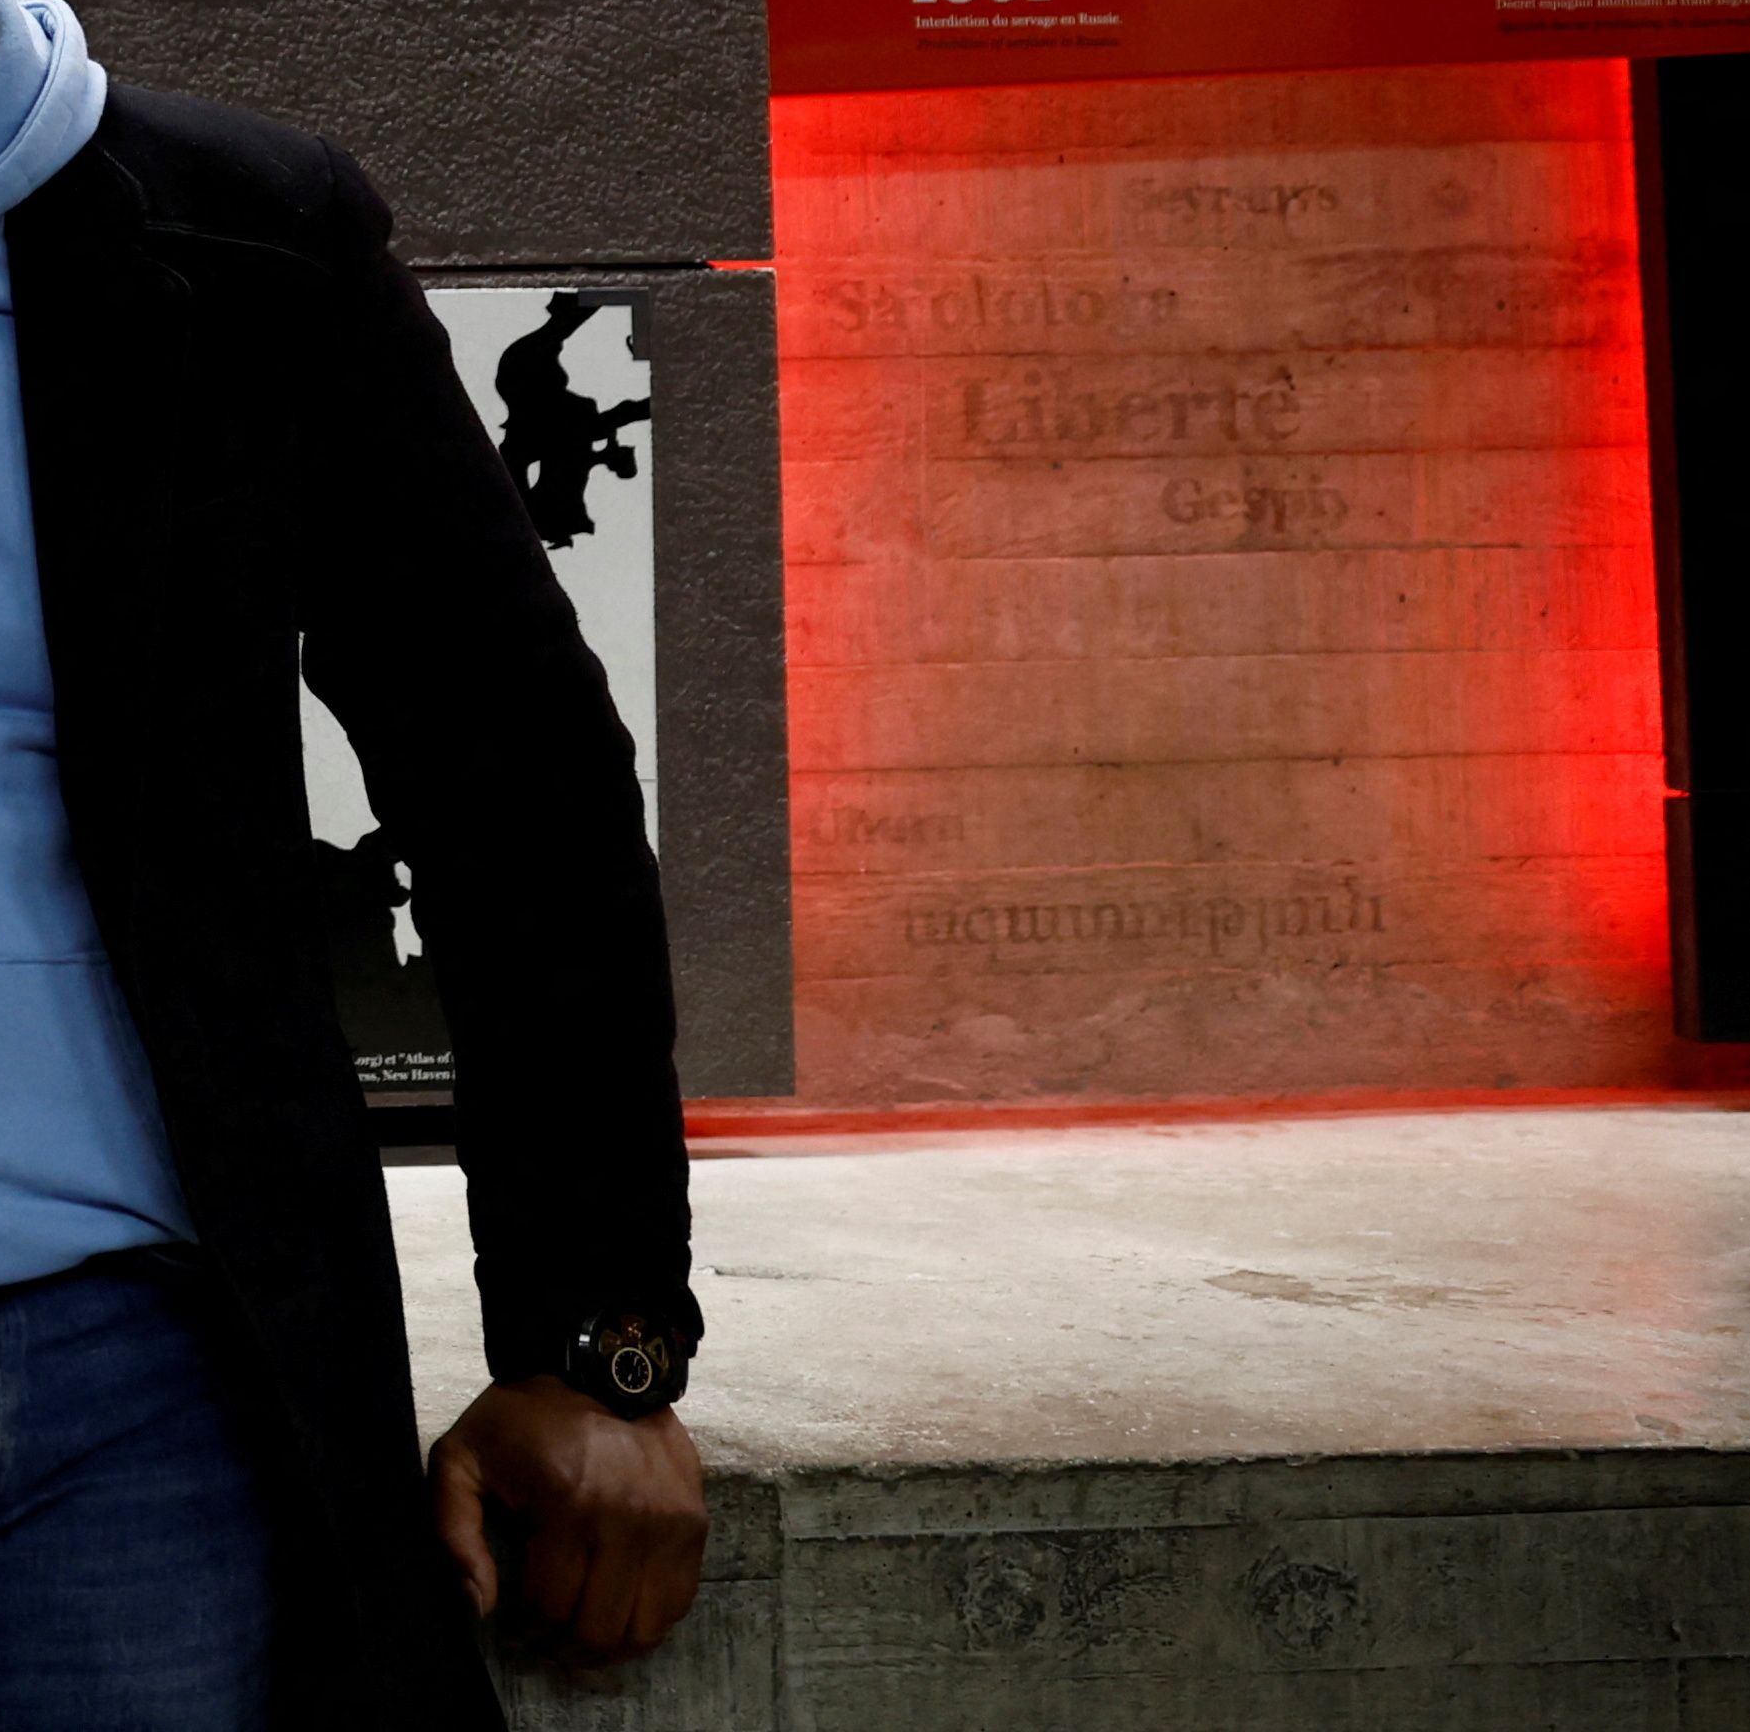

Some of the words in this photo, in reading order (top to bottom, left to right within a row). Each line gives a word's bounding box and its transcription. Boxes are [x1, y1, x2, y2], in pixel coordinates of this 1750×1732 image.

[916, 15, 989, 29] Interdiction
[1011, 15, 1058, 30] servage
[1060, 15, 1076, 26] en
[1078, 12, 1123, 26] Russie.
[385, 1053, 397, 1065] et
[436, 1051, 451, 1064] of
[383, 1070, 409, 1082] New
[412, 1069, 451, 1082] Haven
